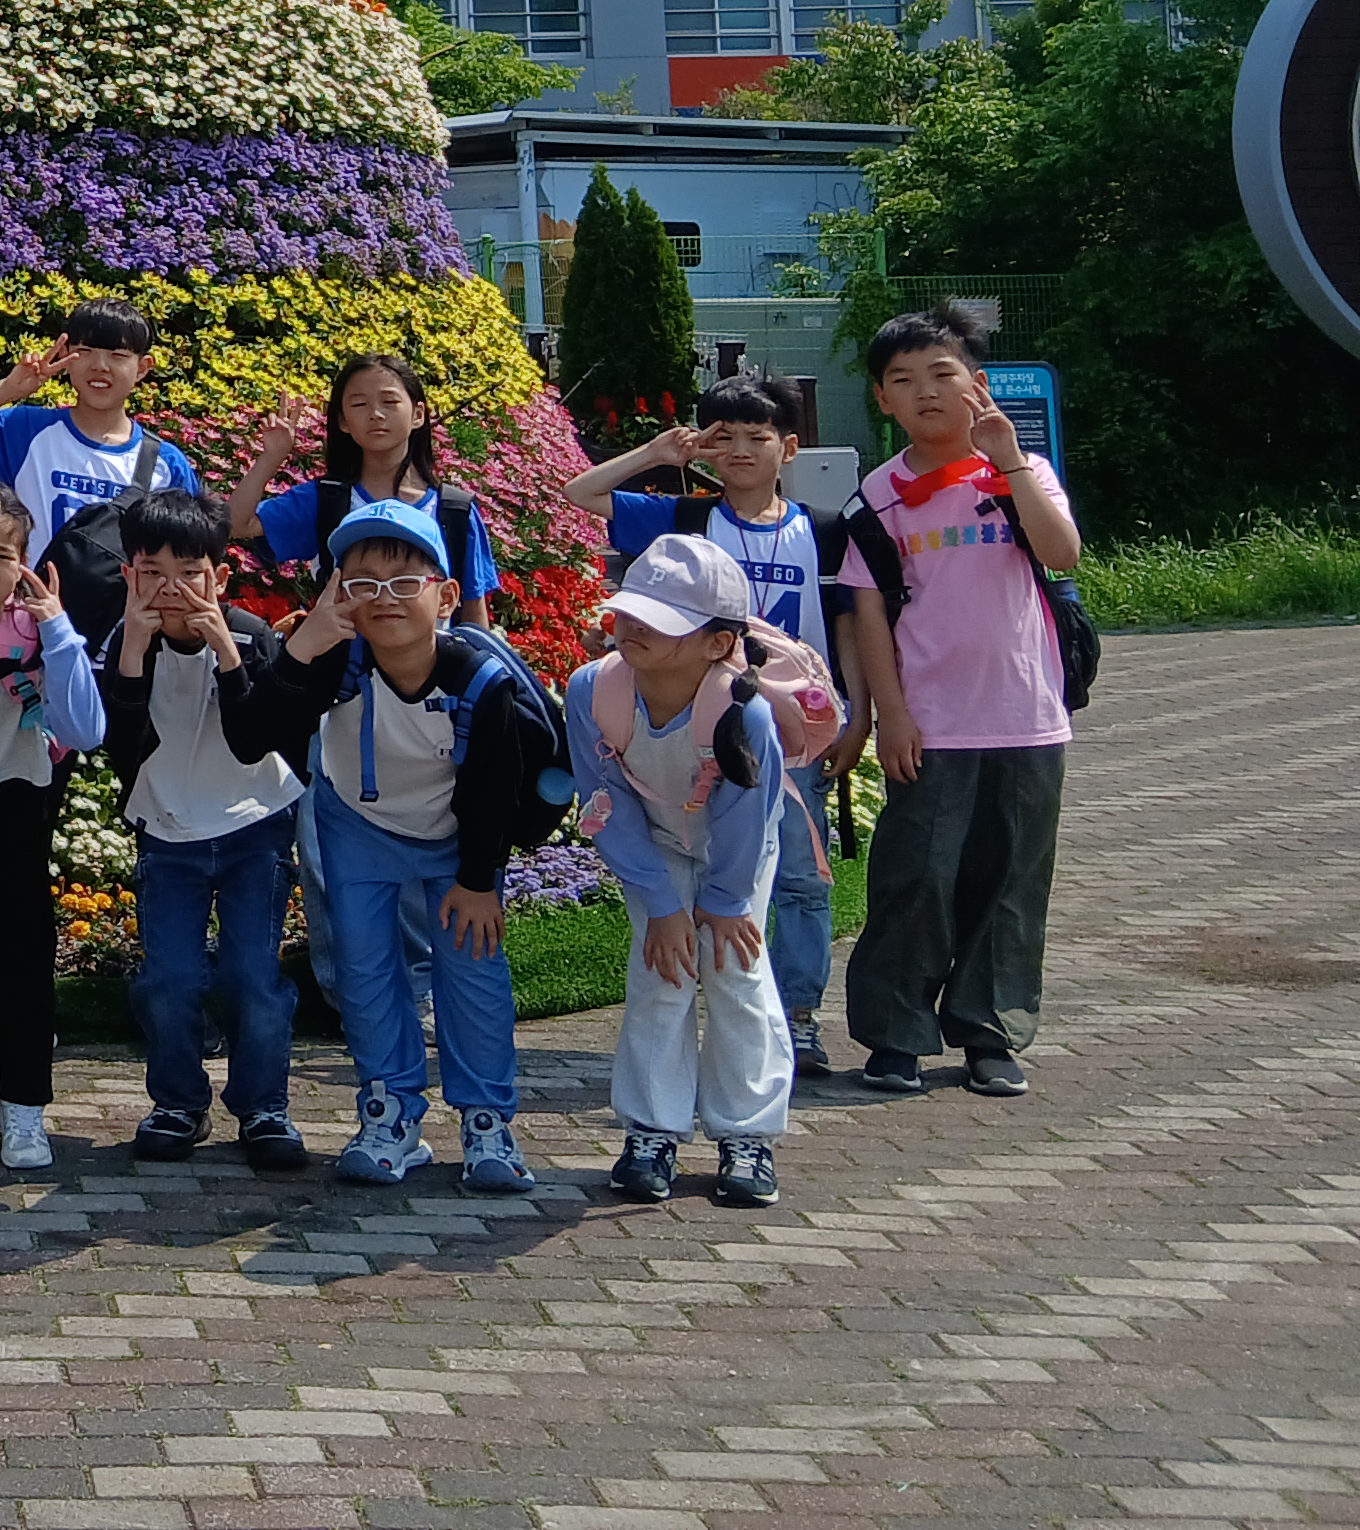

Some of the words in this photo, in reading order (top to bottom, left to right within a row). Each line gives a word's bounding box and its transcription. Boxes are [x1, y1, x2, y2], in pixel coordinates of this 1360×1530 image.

[59, 474, 107, 495] LET'S
[112, 485, 124, 498] G
[646, 567, 667, 586] P
[773, 566, 795, 582] GO
